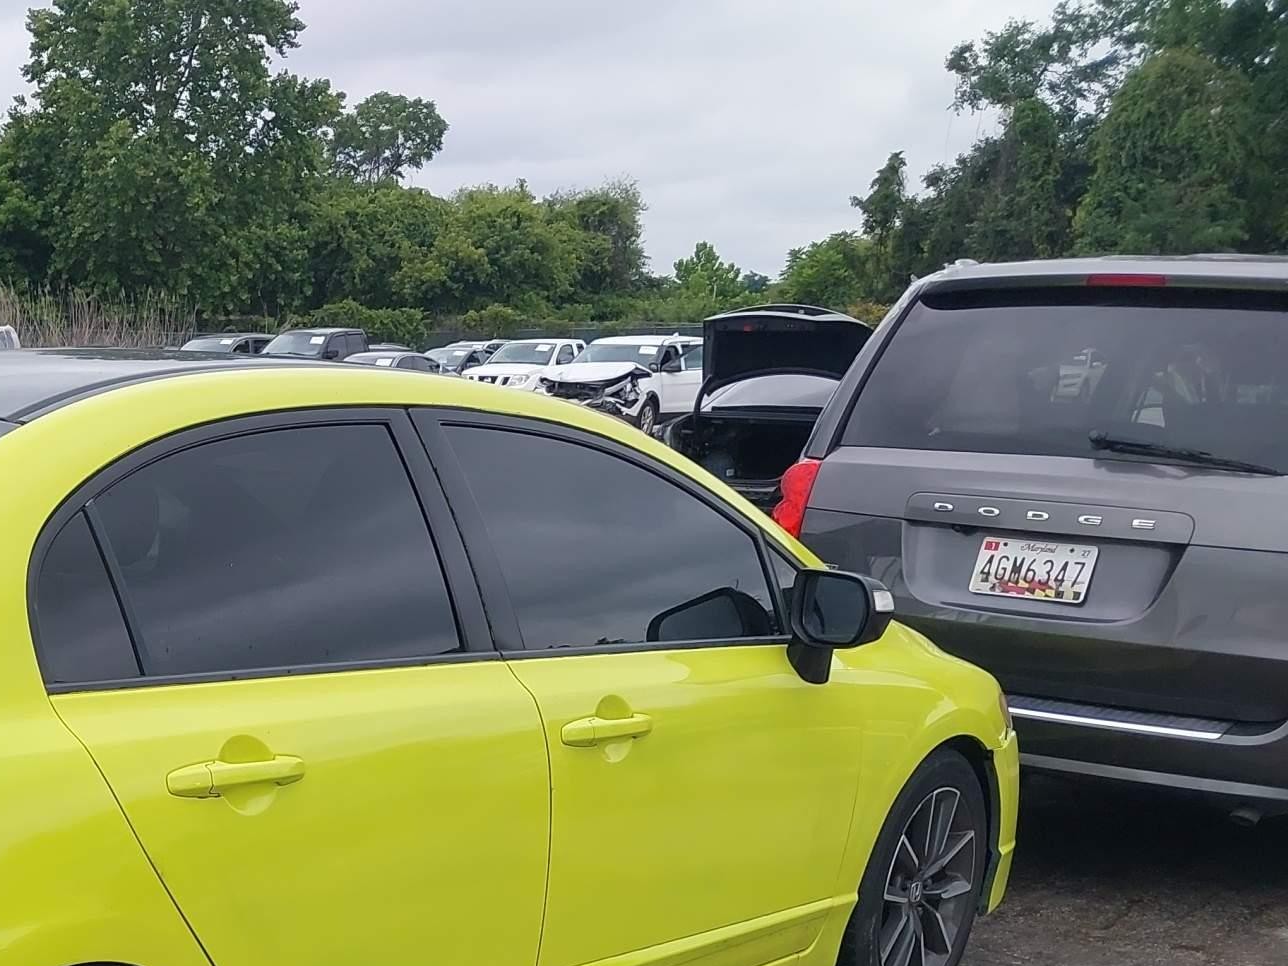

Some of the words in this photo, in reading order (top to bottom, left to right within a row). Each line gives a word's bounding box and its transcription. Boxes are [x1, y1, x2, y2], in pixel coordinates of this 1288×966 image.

[933, 501, 1157, 530] DODGE
[1020, 543, 1058, 555] Maryland
[979, 554, 1087, 589] 4GM6347
